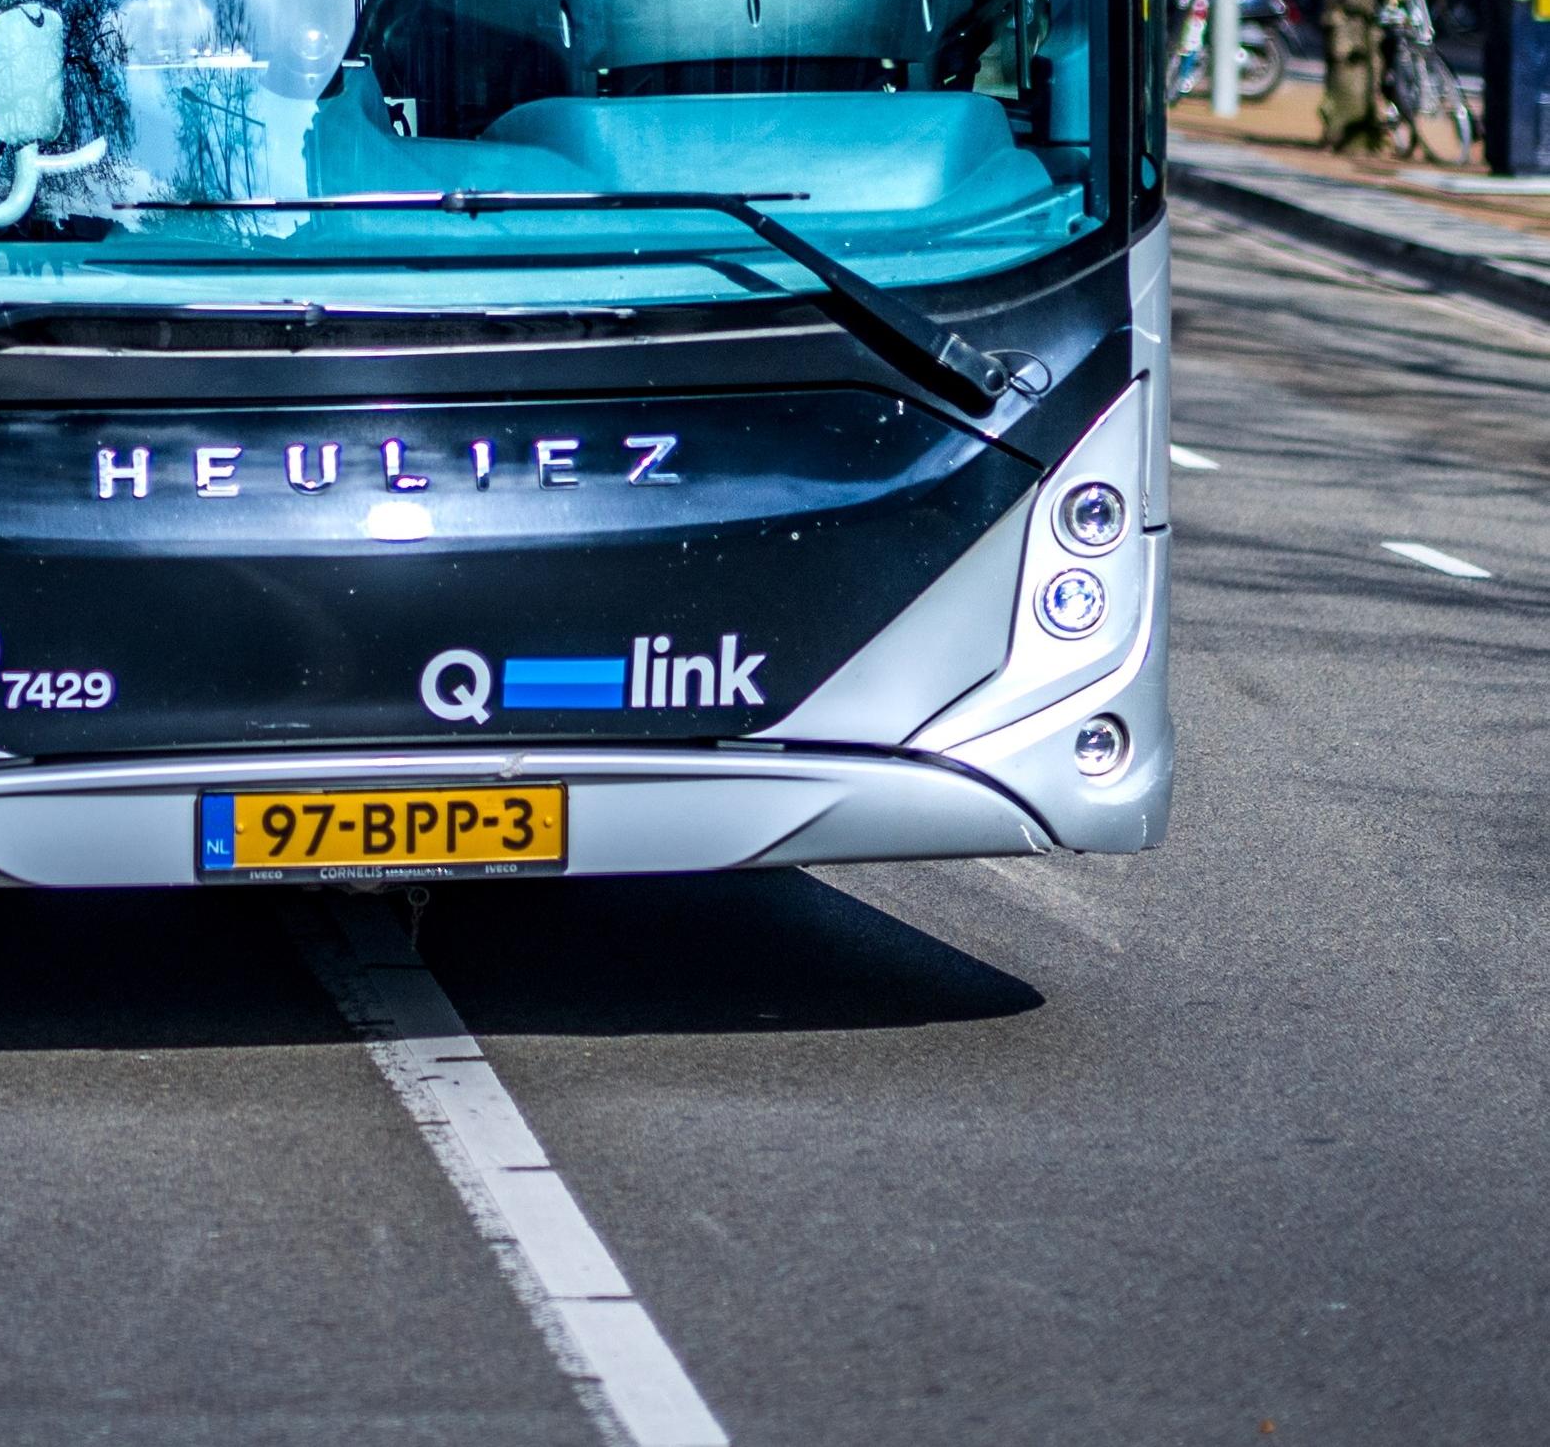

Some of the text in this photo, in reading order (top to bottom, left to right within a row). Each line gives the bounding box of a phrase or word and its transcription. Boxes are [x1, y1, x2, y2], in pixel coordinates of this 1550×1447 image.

[96, 434, 682, 501] HEULIEZ
[1, 670, 114, 711] 7429
[206, 838, 230, 856] NL
[261, 796, 536, 859] 97-BPP-3
[250, 870, 283, 881] IVECO
[319, 866, 384, 881] CORNELIS
[484, 862, 518, 875] IVECO
